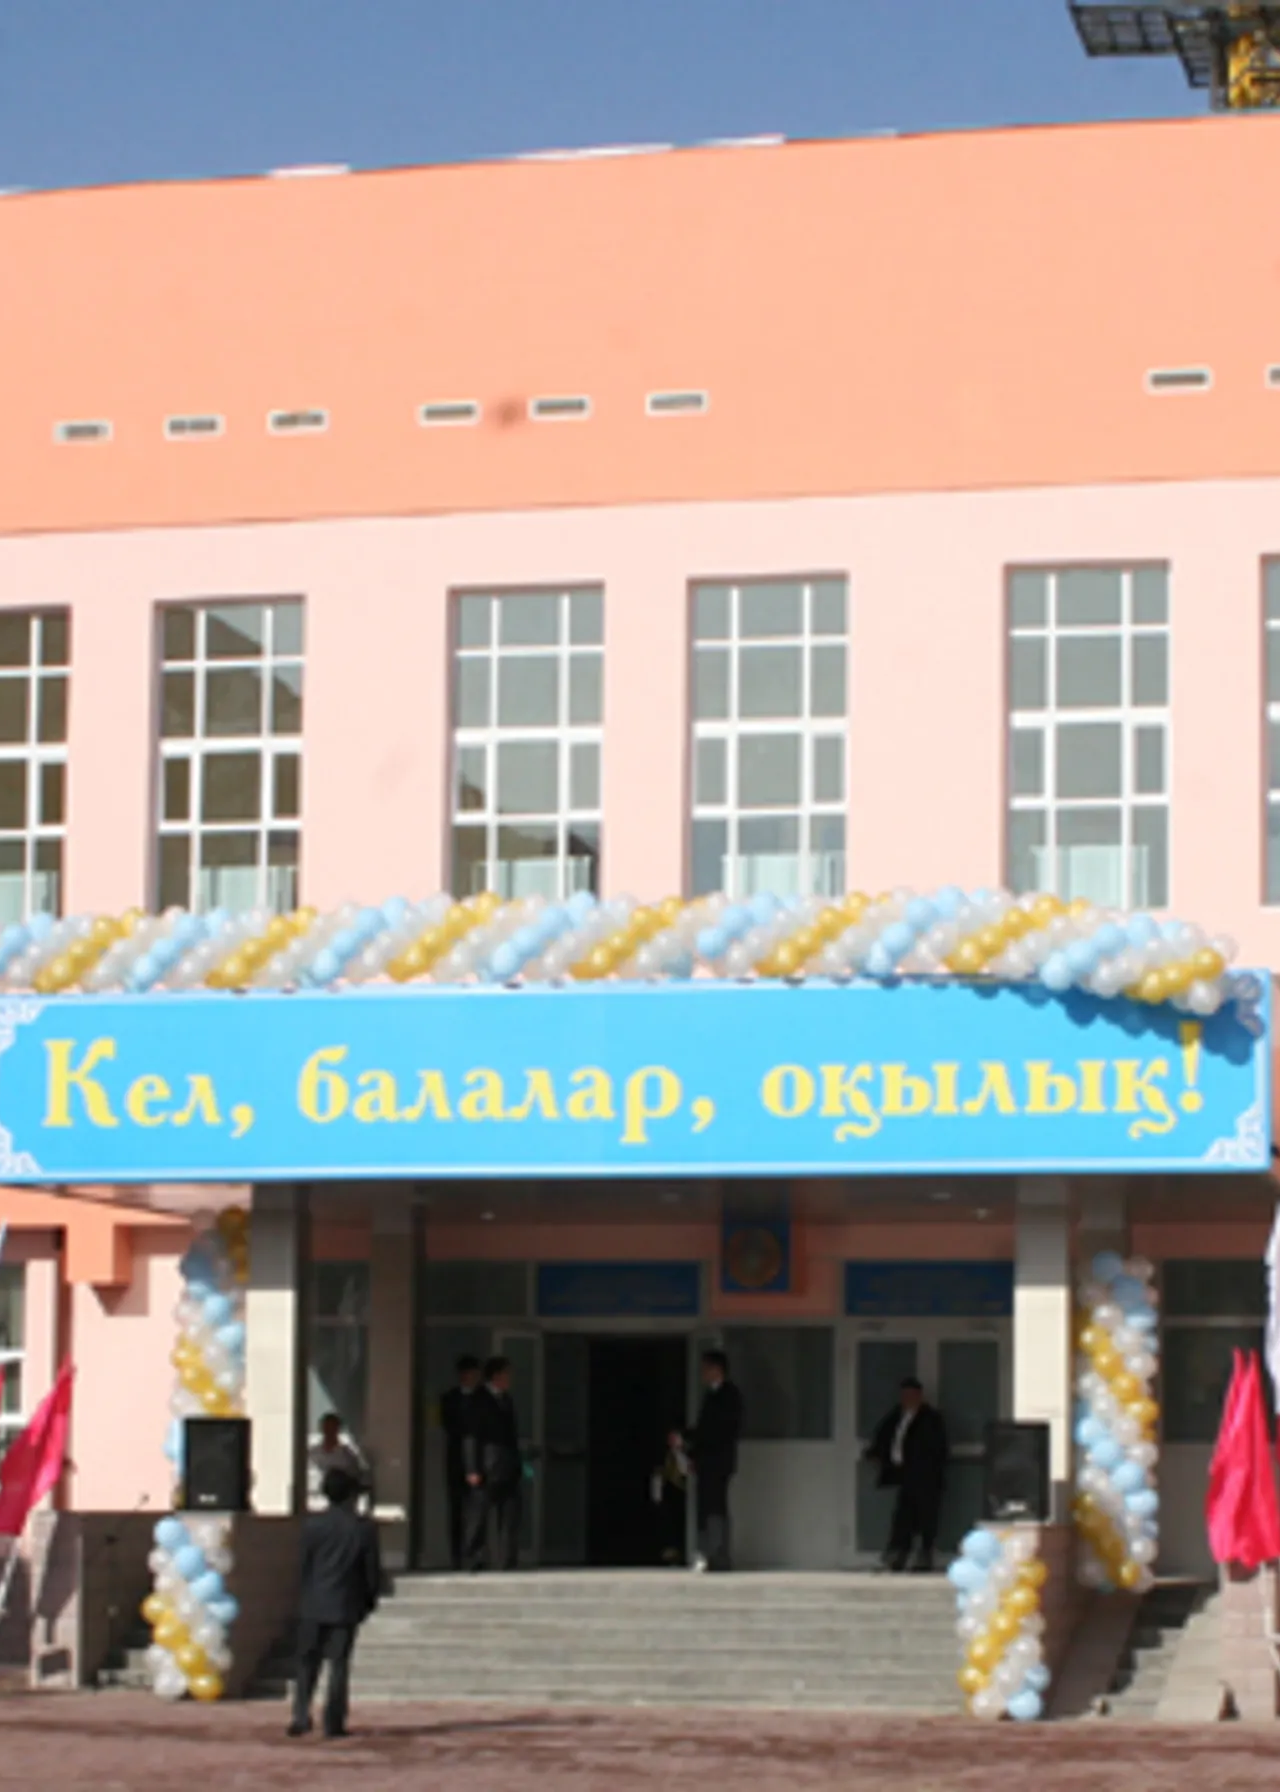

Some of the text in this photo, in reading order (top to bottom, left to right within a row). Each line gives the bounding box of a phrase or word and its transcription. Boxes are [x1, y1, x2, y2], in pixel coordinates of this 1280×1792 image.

[44, 1020, 1204, 1144] Кел, балалар, оқылық!
